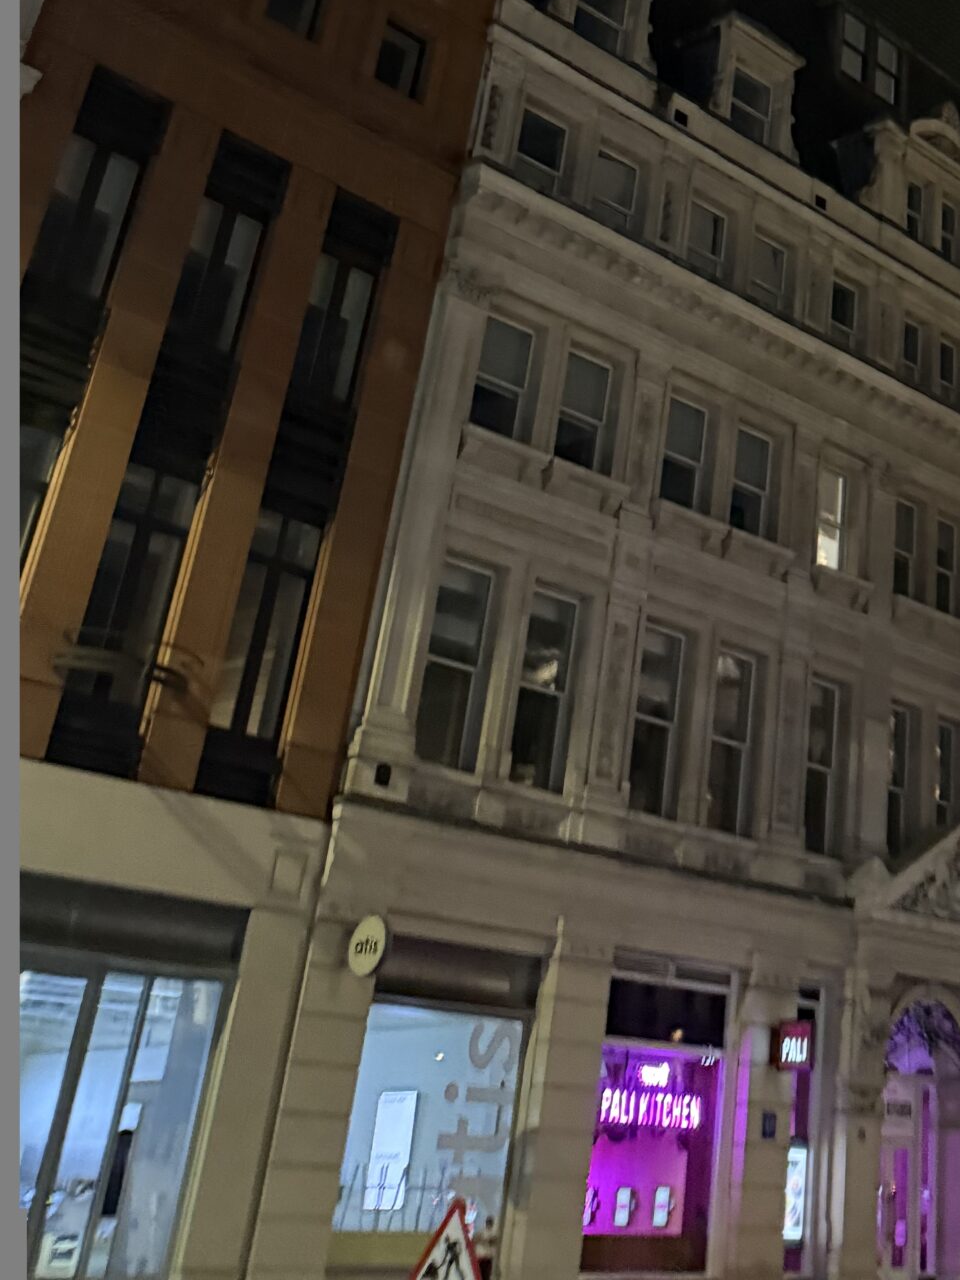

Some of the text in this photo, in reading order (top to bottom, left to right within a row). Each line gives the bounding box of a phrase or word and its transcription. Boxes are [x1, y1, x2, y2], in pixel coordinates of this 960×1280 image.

[355, 935, 378, 955] atis
[781, 1035, 808, 1063] PALI
[600, 1087, 701, 1130] PALI KITCHEN
